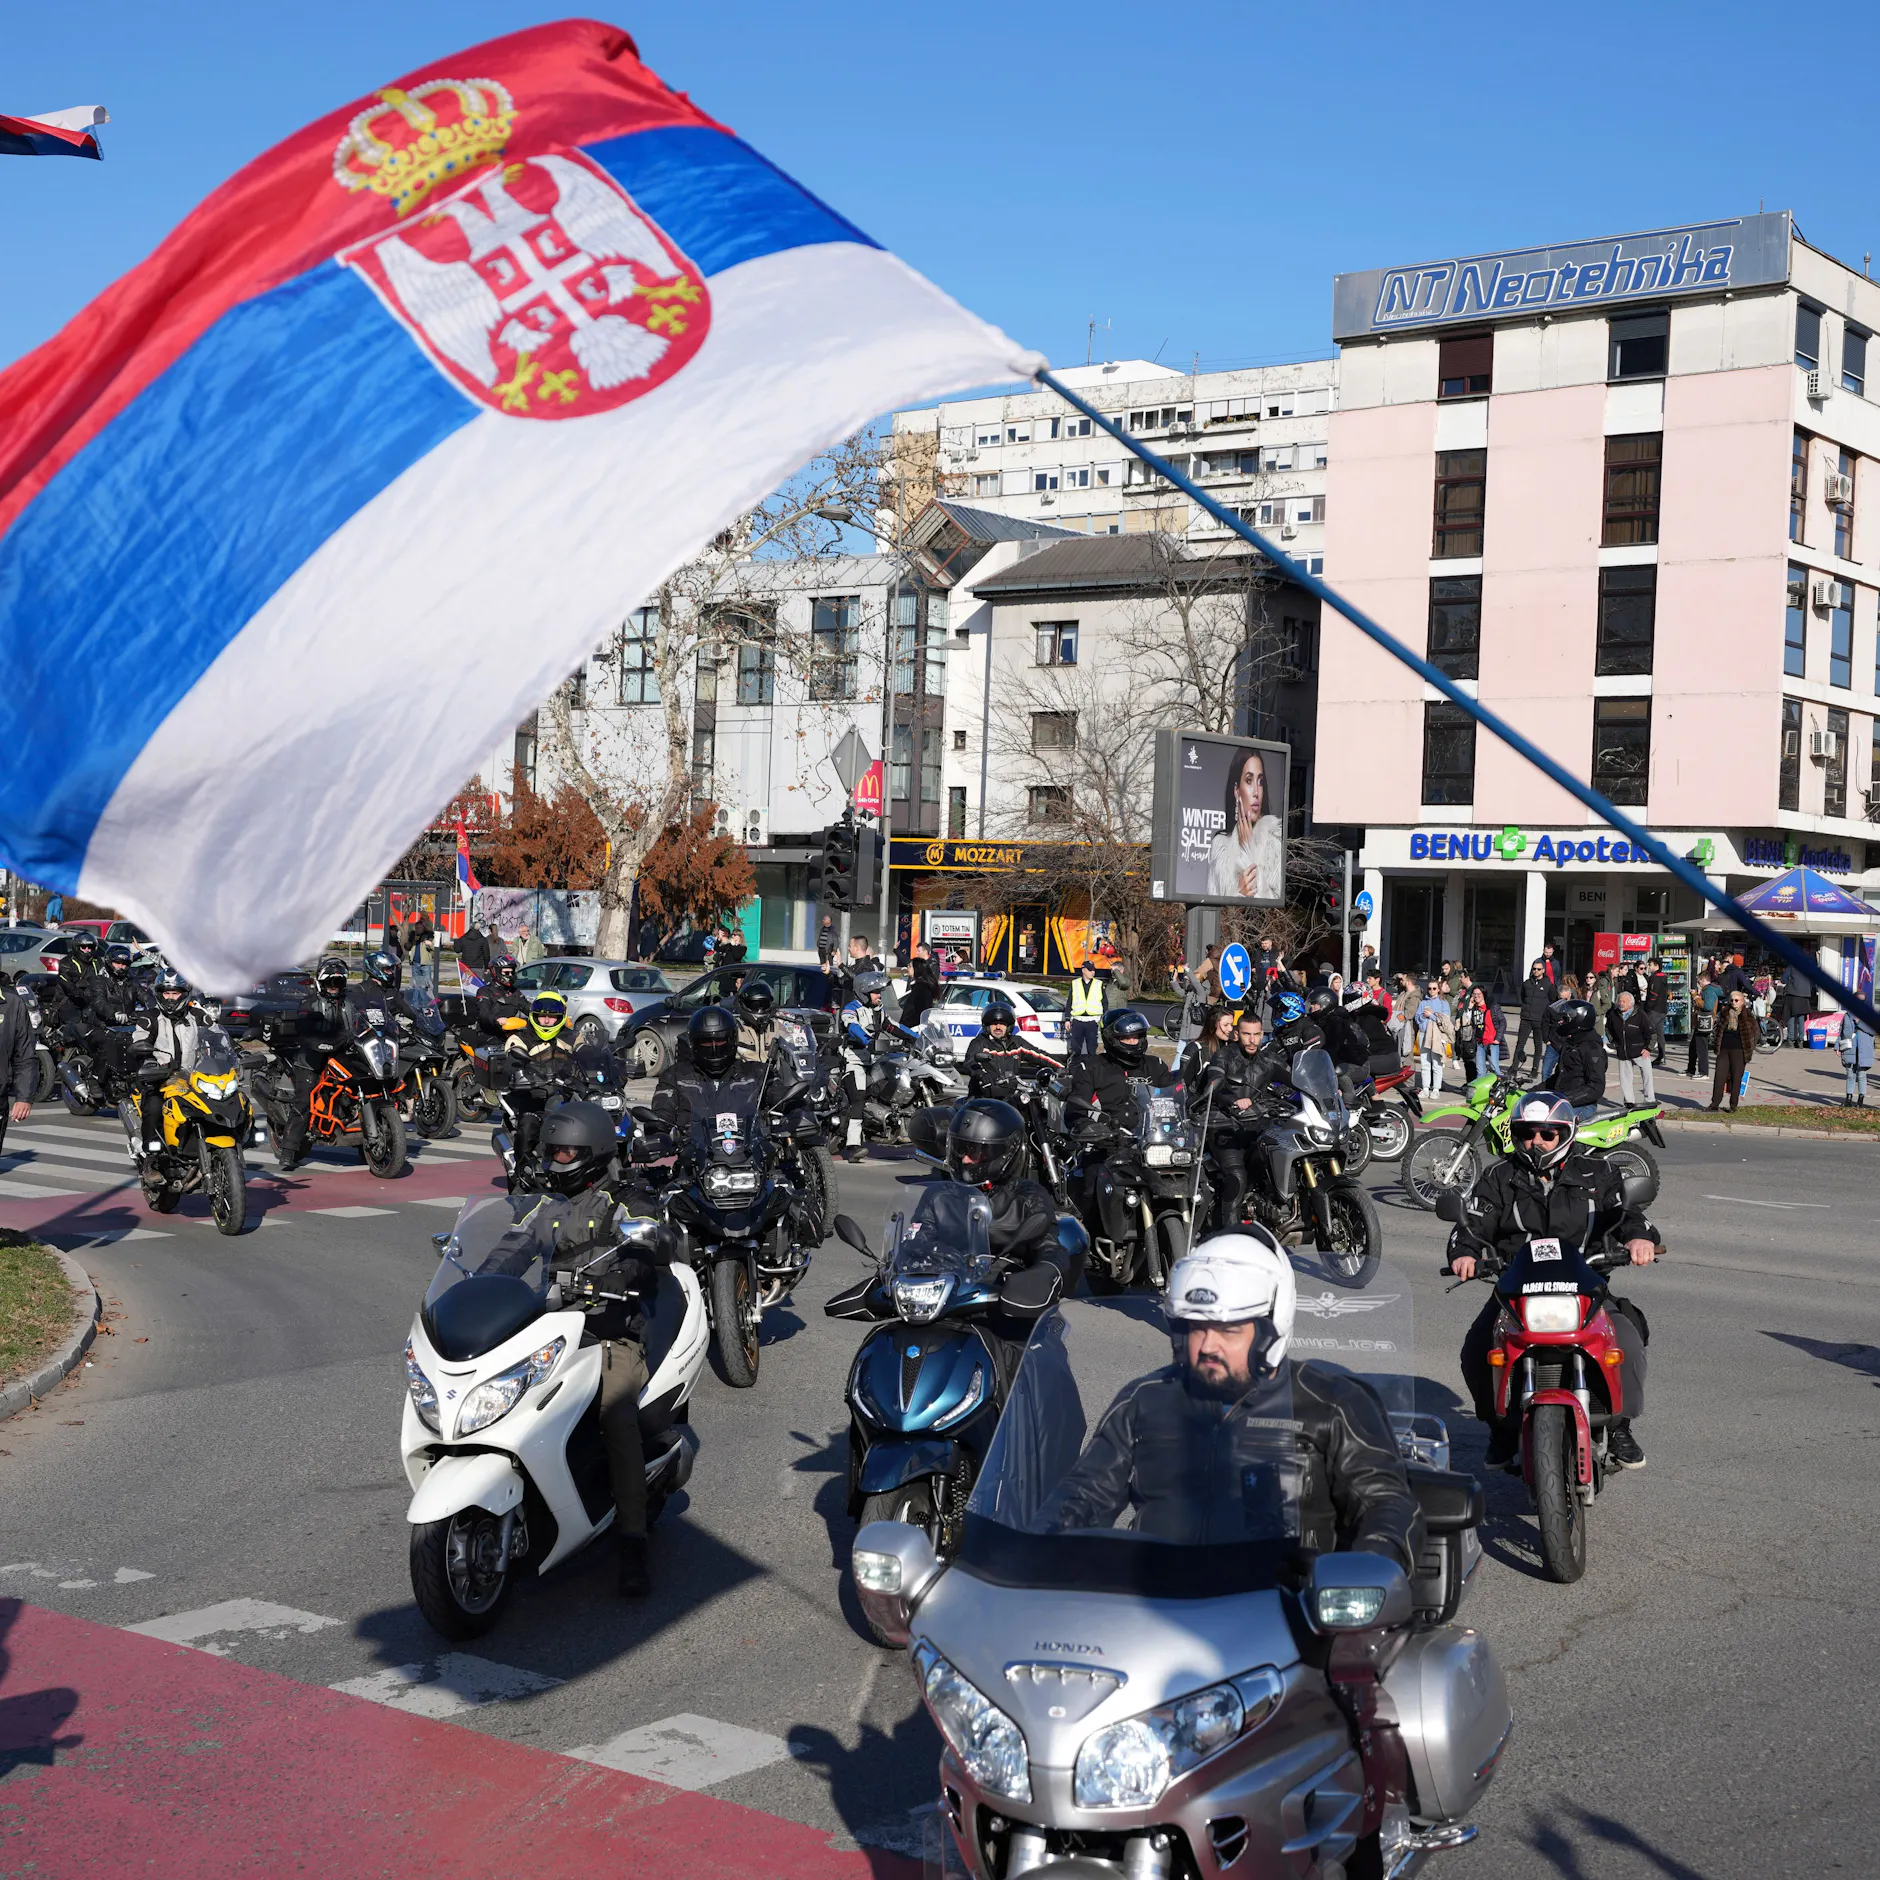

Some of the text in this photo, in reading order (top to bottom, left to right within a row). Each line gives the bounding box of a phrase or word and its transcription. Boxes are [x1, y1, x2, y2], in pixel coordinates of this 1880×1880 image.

[1386, 234, 1734, 314] NT Neotehnika
[1182, 808, 1227, 830] WINTER
[1181, 828, 1212, 849] SALE
[1410, 834, 1491, 860] BENU
[954, 847, 1024, 864] MOZZART
[942, 924, 960, 932] TOTEM
[1552, 1281, 1578, 1292] STUDENTE
[1034, 1640, 1105, 1655] HONDA
